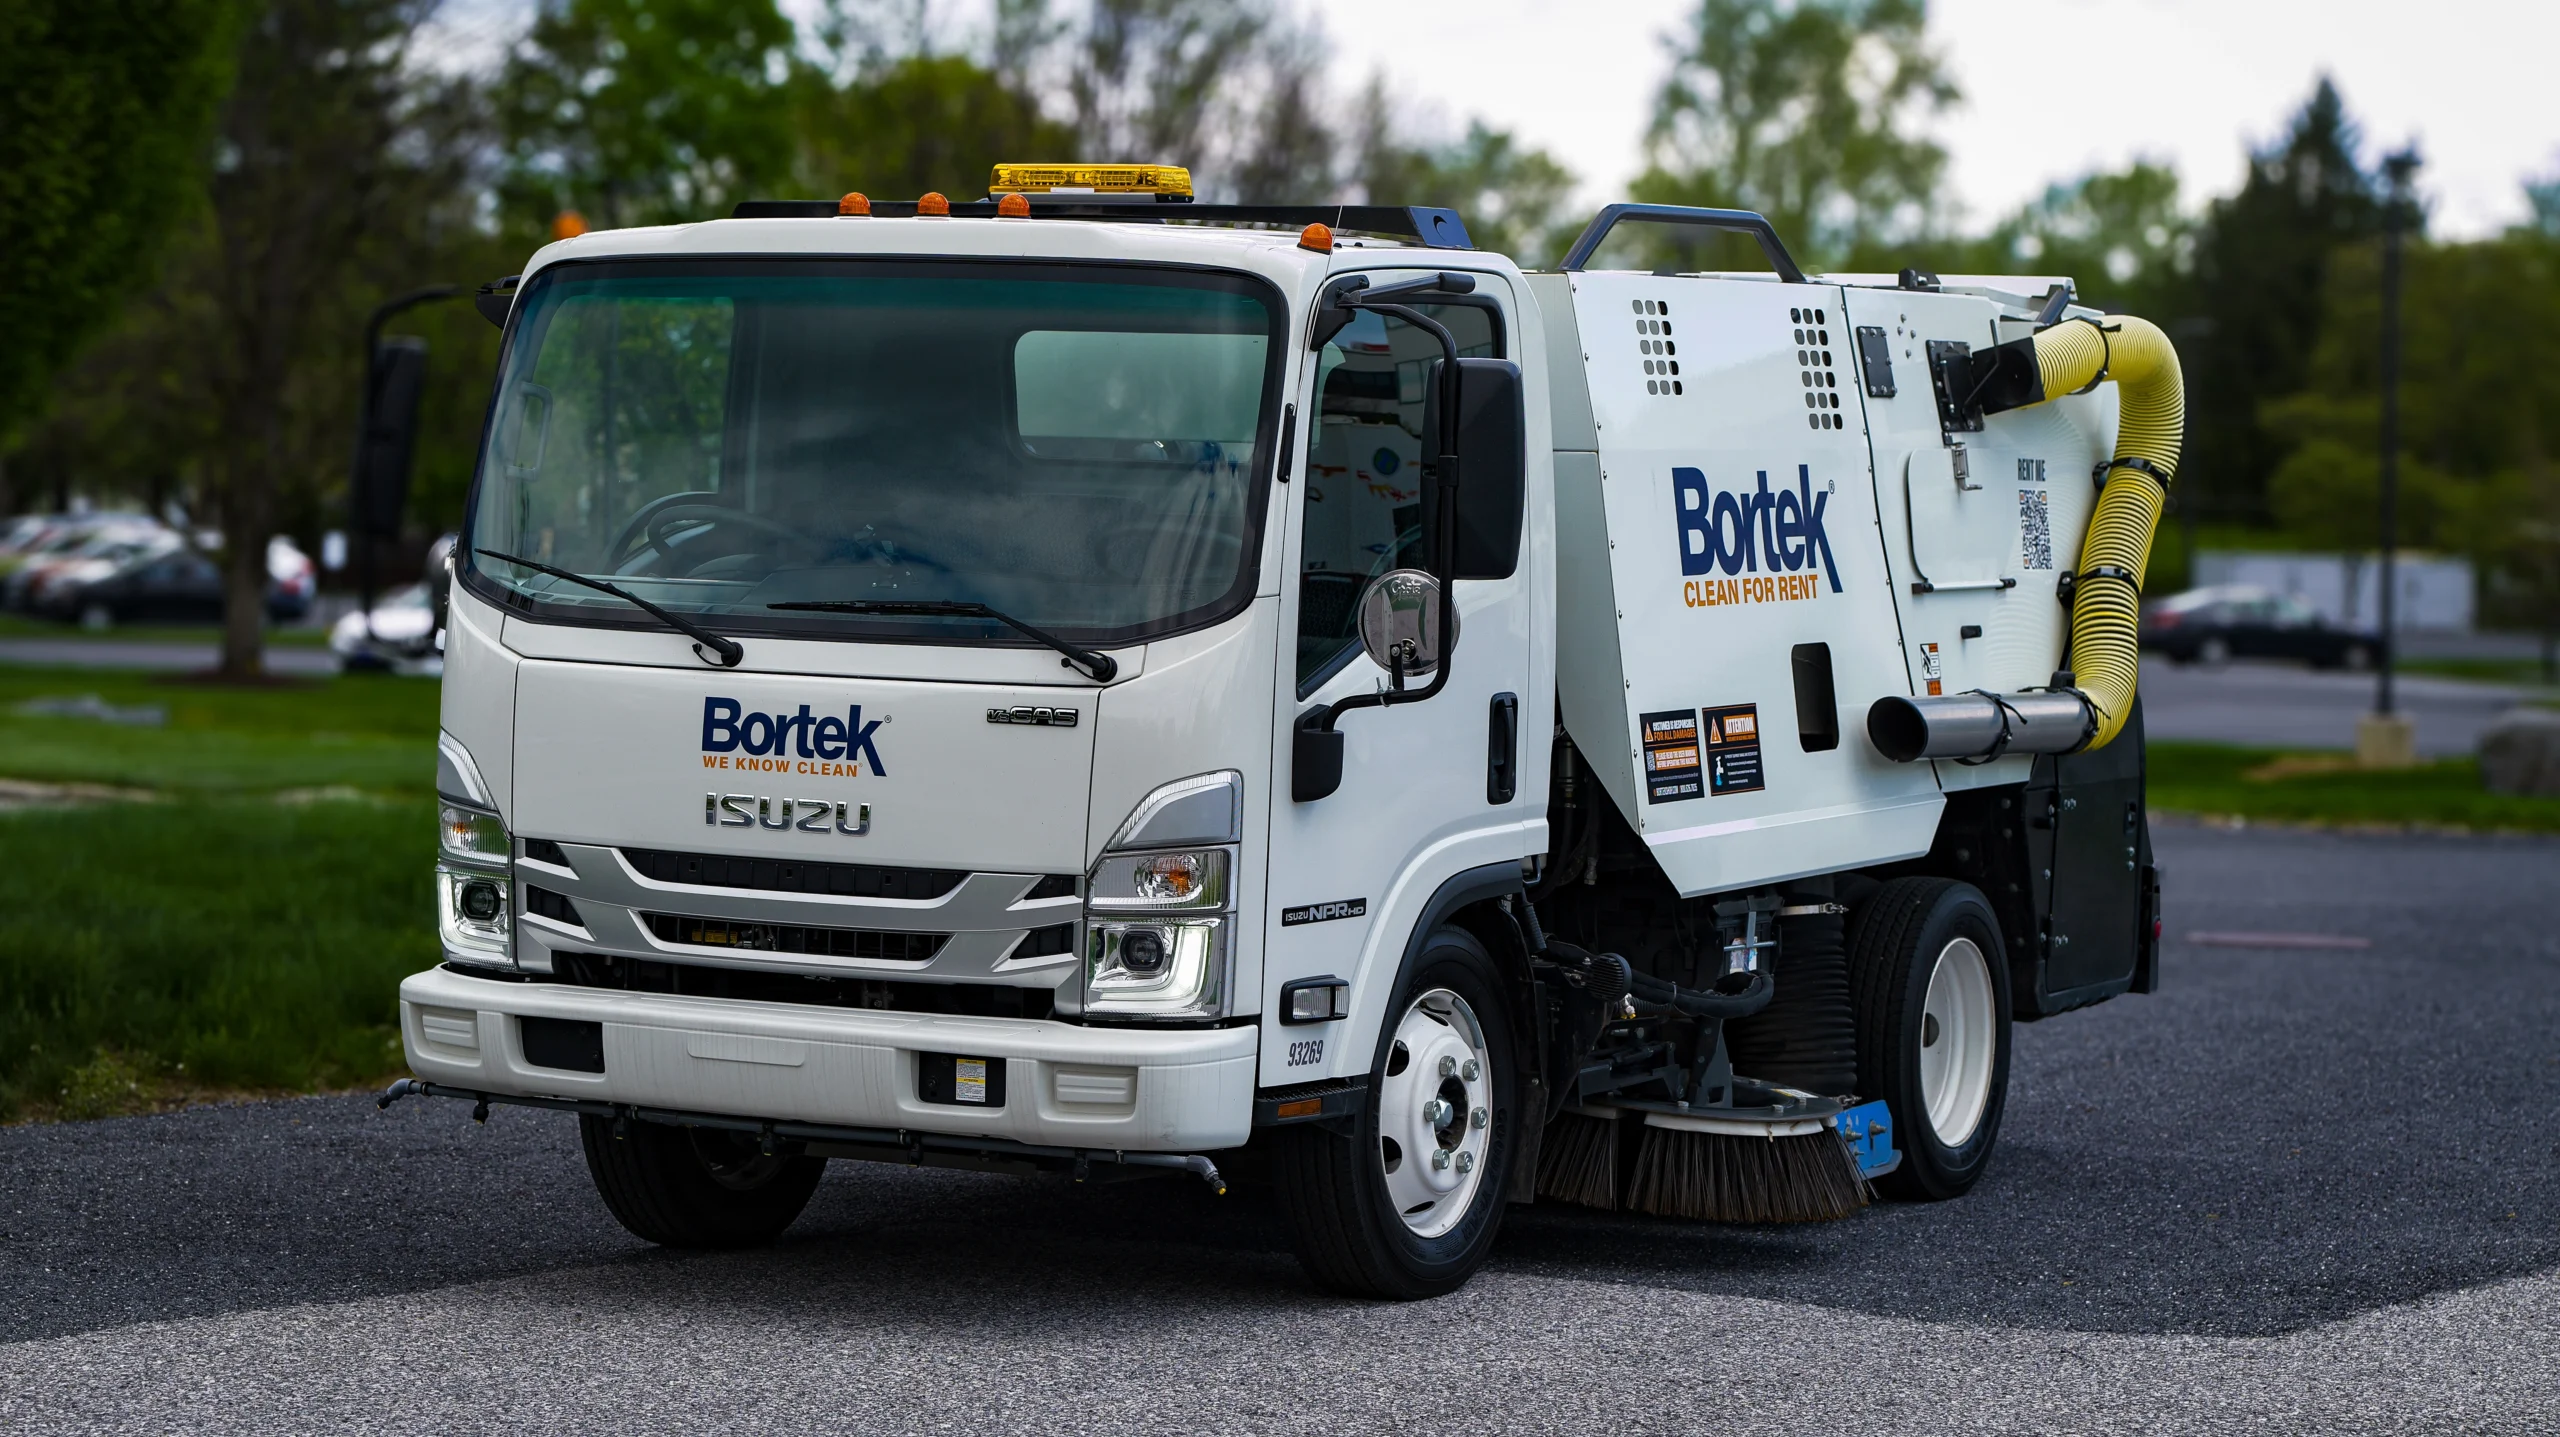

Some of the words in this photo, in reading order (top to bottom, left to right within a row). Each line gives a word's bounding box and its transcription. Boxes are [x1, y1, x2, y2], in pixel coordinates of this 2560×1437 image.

[2017, 458, 2034, 481] RENT
[2035, 459, 2046, 482] ME
[1684, 579, 1739, 608] CLEAN
[1742, 577, 1775, 604] FOR
[1778, 574, 1818, 602] RENT
[1654, 732, 1664, 741] FOR
[1664, 731, 1673, 740] ALL
[1673, 728, 1696, 739] DAMAGES
[703, 756, 729, 769] WE
[736, 758, 791, 772] KNOW
[797, 762, 858, 777] CLEAN
[705, 792, 871, 837] ISUZU
[1286, 911, 1308, 922] ISUZU
[1309, 903, 1348, 921] NPR
[1348, 906, 1364, 915] HD
[1288, 1040, 1324, 1067] 93269
